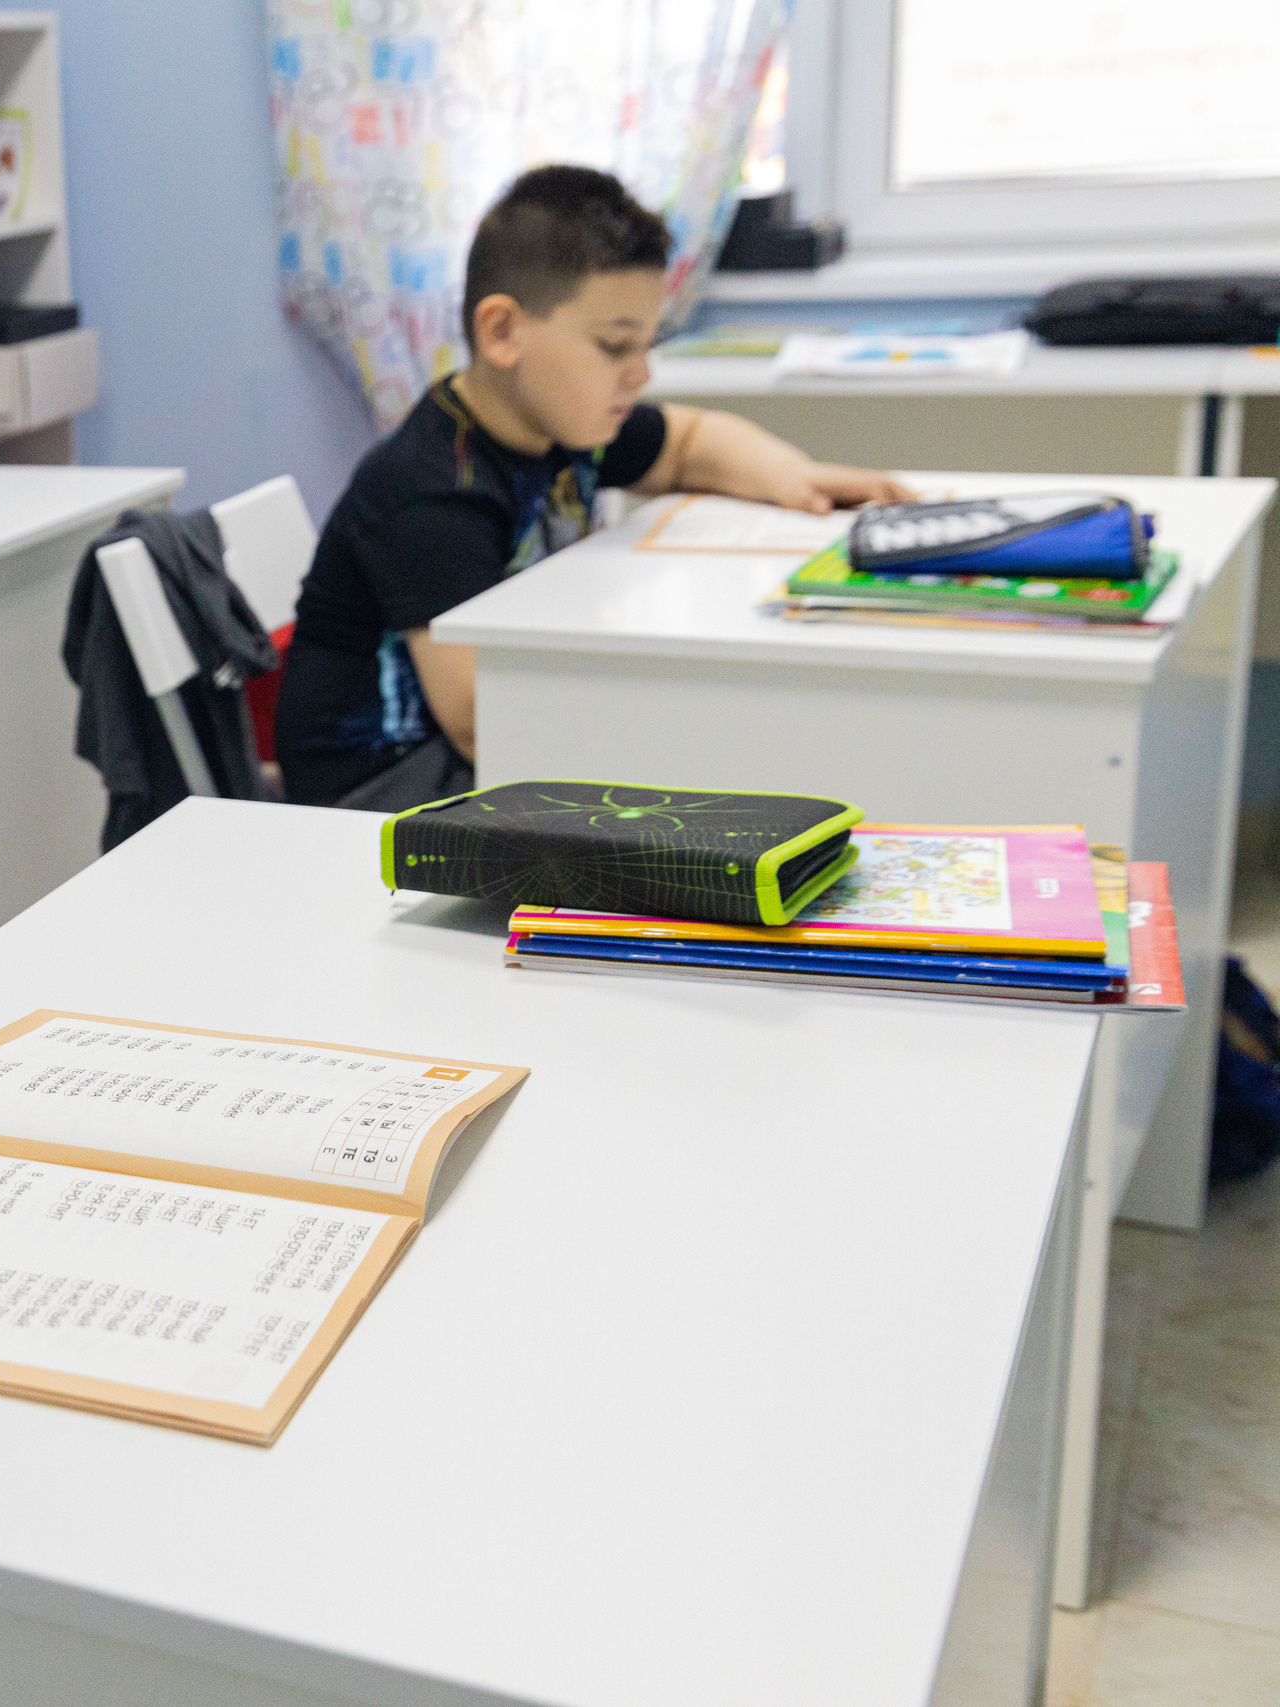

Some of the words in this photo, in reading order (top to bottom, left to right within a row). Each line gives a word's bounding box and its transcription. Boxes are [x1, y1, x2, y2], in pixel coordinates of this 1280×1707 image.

[379, 1119, 397, 1130] ТЫ
[341, 1147, 358, 1161] ТЕ
[362, 1149, 379, 1164] ТЭ
[0, 1181, 33, 1215] тём-ной
